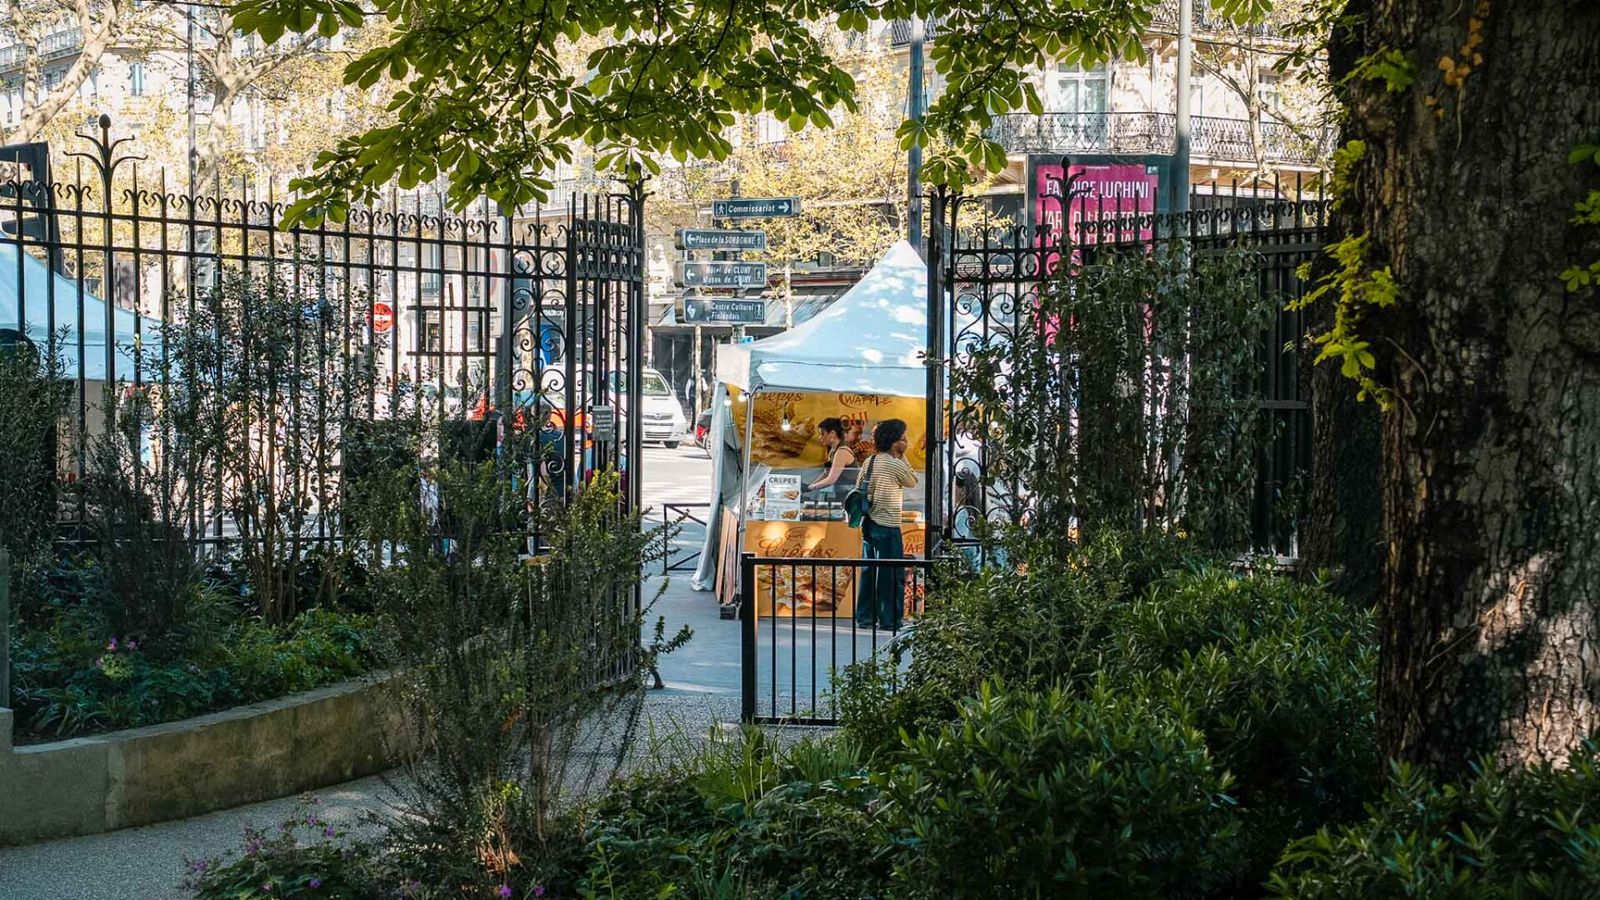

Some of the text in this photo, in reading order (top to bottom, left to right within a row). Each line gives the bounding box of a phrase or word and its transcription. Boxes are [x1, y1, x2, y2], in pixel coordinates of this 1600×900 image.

[1046, 180, 1149, 198] FARICE LUCHINI
[728, 204, 775, 213] Commissariat
[696, 235, 755, 245] Place de la SORBONNE
[724, 266, 731, 274] de
[733, 266, 752, 274] CLUNY
[724, 275, 731, 283] de
[732, 303, 754, 311] Culturel
[844, 395, 892, 406] WAFFLE
